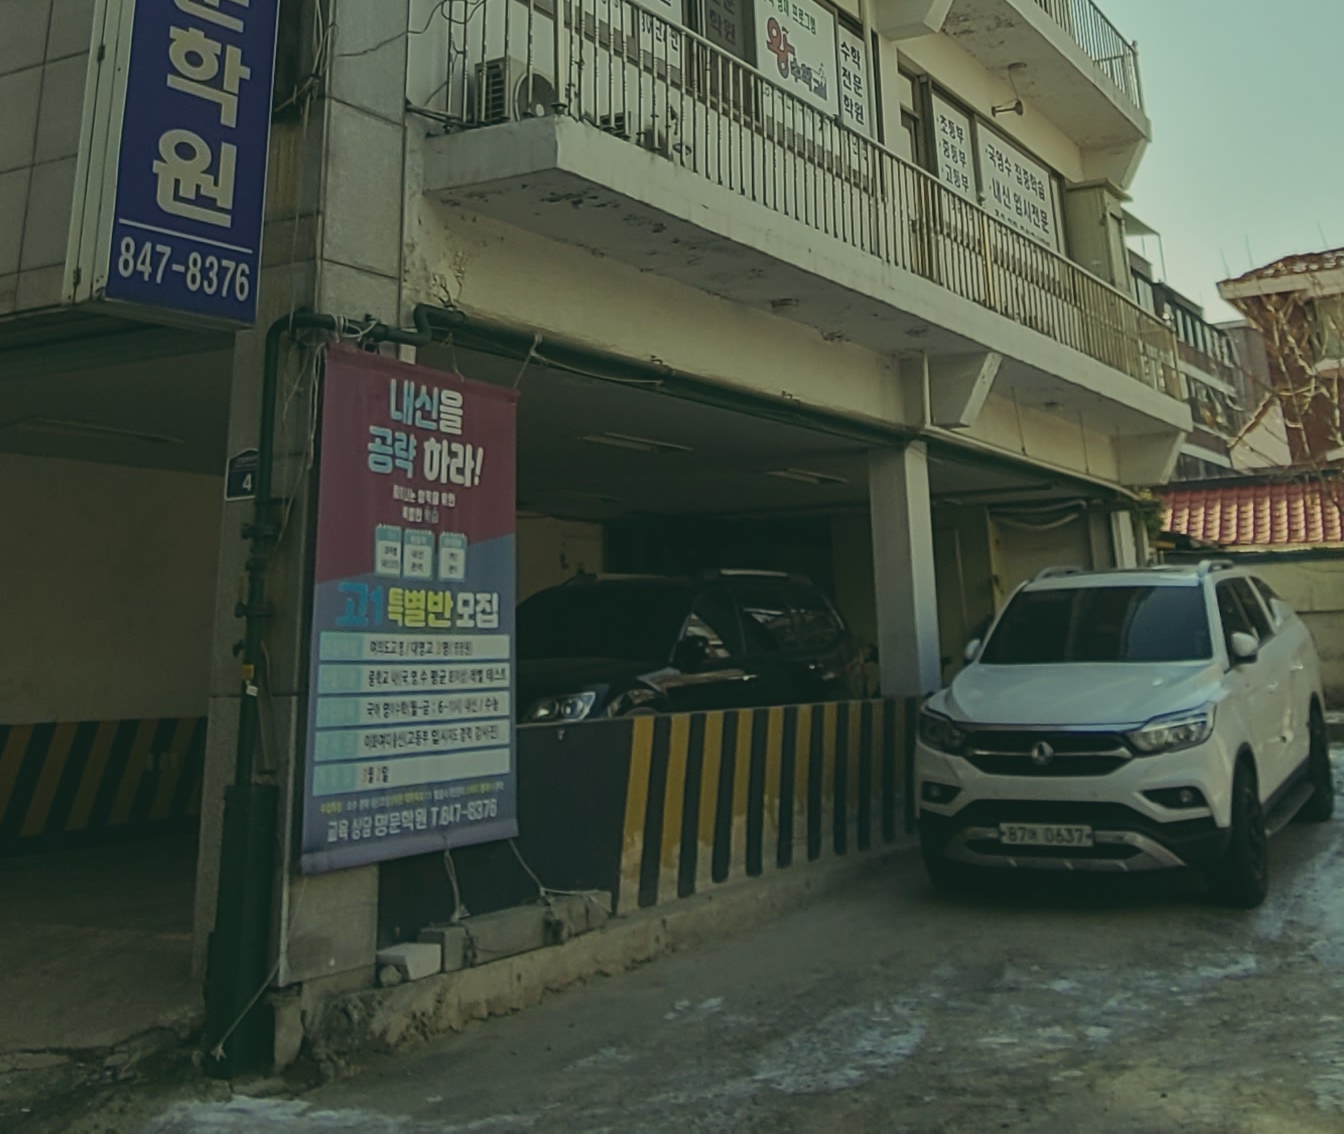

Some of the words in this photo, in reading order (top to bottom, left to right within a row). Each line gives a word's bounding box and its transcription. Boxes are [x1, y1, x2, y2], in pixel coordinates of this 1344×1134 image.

[792, 4, 816, 35] 프로그램
[841, 41, 861, 71] 수학
[841, 67, 863, 98] 전문
[842, 94, 865, 126] 학원
[939, 114, 964, 144] 초등부
[941, 139, 967, 169] 중등부
[944, 164, 969, 193] 고등부
[987, 143, 1013, 177] 국영수
[1014, 163, 1046, 202] 집중학습
[992, 178, 1012, 211] 내신
[1013, 193, 1050, 235] 입시전문
[118, 237, 250, 302] 847-8376
[389, 377, 463, 436] 내신을
[368, 425, 417, 479] 공략
[423, 437, 484, 487] 하라!
[337, 582, 383, 626] 고1
[387, 587, 453, 628] 특별반
[456, 591, 499, 629] 모집
[374, 808, 428, 838] 명문학원
